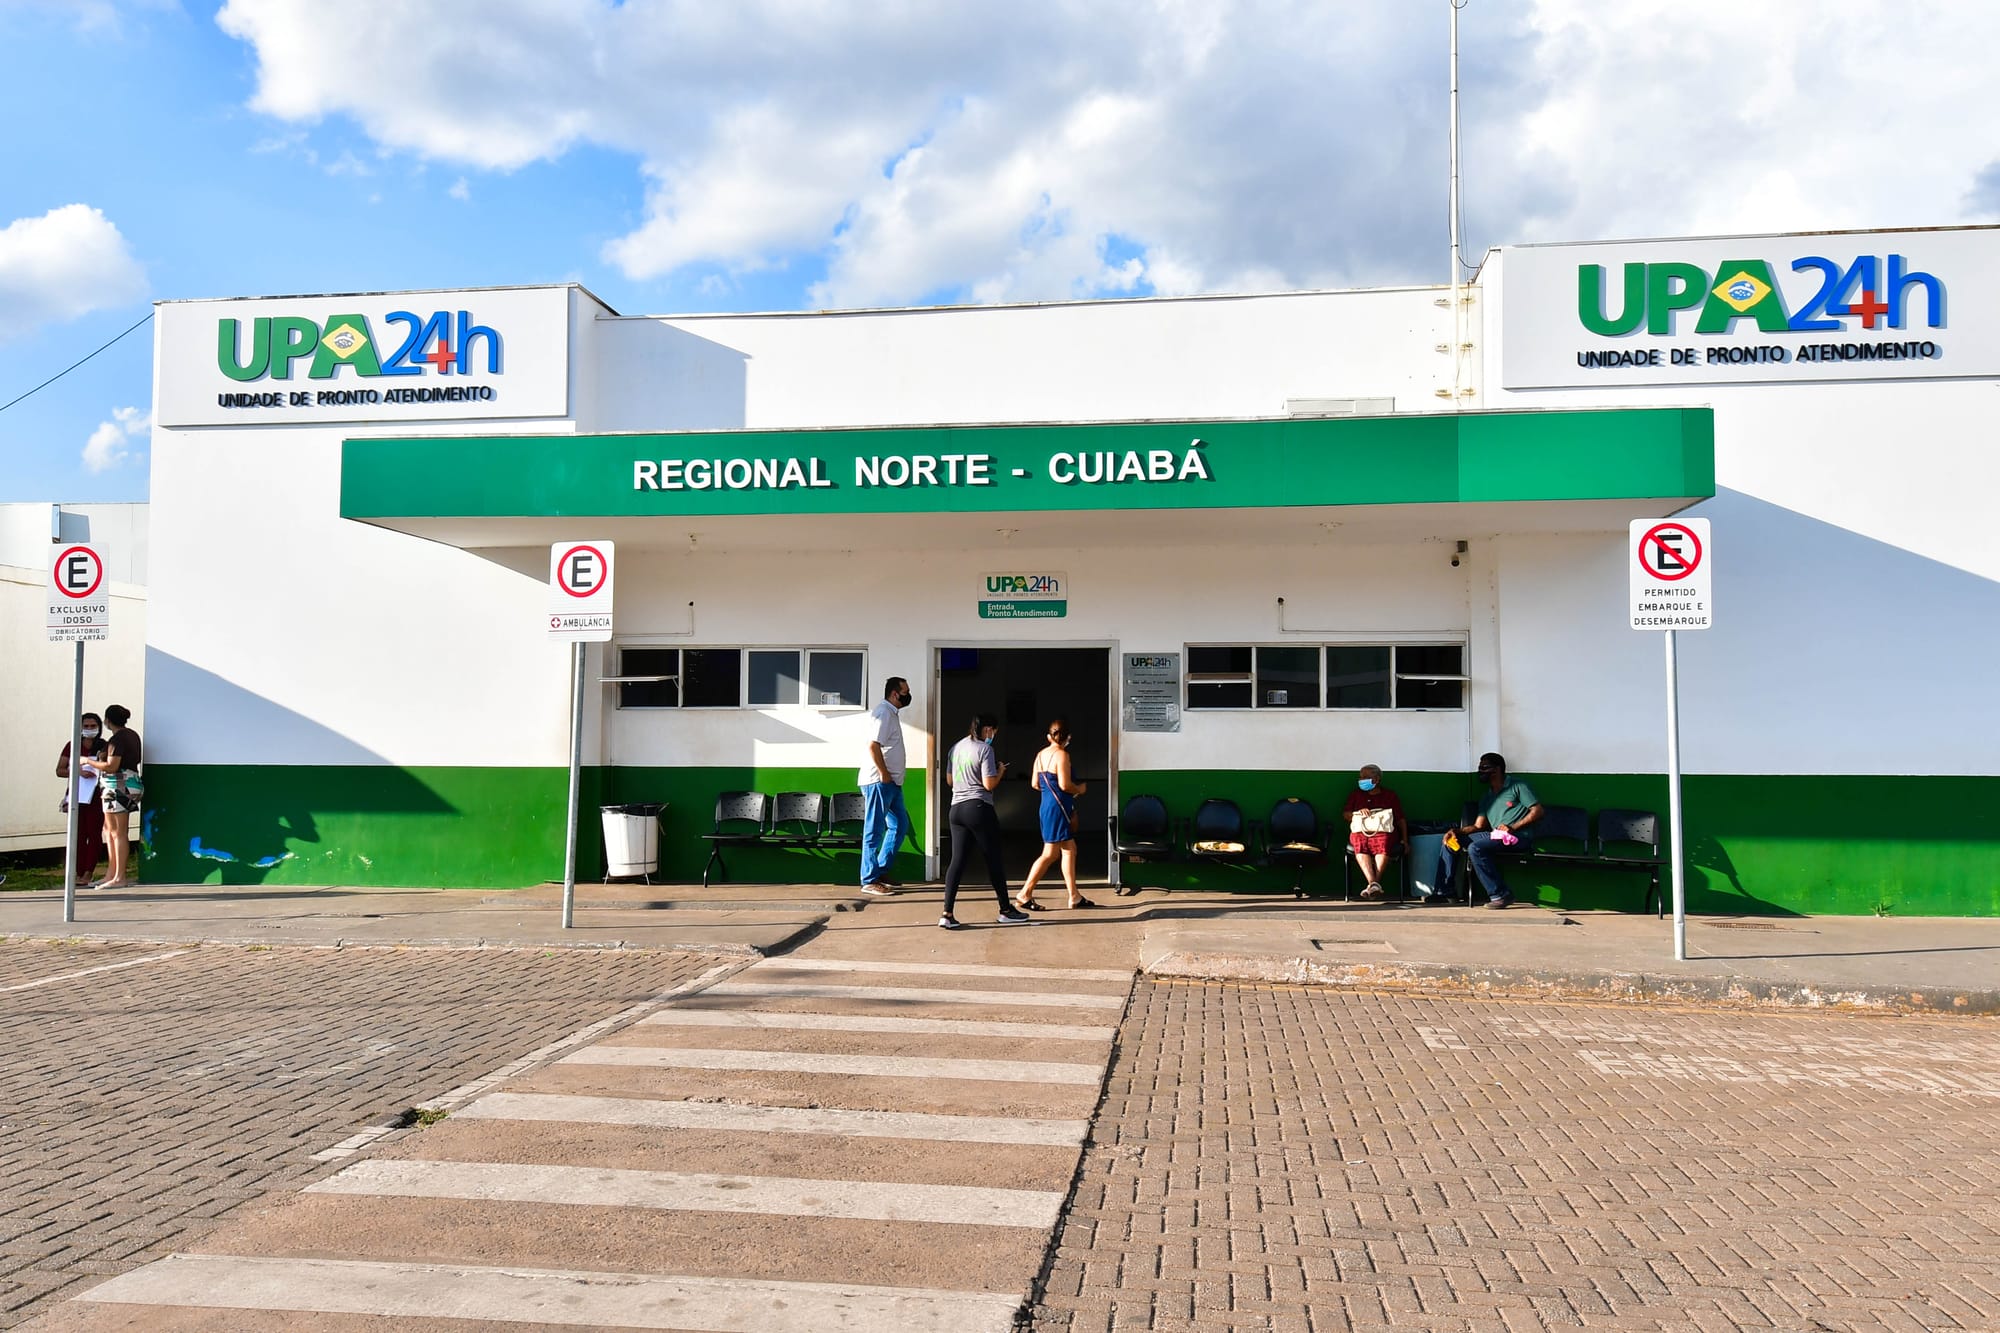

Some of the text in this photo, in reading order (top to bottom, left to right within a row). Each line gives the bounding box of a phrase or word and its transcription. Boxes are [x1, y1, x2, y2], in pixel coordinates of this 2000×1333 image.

[1577, 340, 1936, 368] UNIDADE DE PRONTO ATENDIMENTO
[218, 385, 492, 408] UNIDADE DE PRONTO ATENDIMENTO
[633, 457, 831, 490] REGIONAL
[855, 454, 990, 487] NORTE
[1049, 438, 1208, 484] CUIABÁ
[1657, 534, 1685, 570] E
[68, 556, 89, 588] E
[572, 555, 593, 588] E
[1644, 588, 1697, 597] PERMITIDO
[50, 605, 106, 614] EXCLUSIVO
[1012, 609, 1059, 617] Atendimento
[1639, 602, 1704, 611] EMBARQUE E
[63, 616, 93, 624] IDOSO
[1634, 617, 1708, 626] DESEMBARQUE
[1576, 1049, 2000, 1099] EMBARQU
